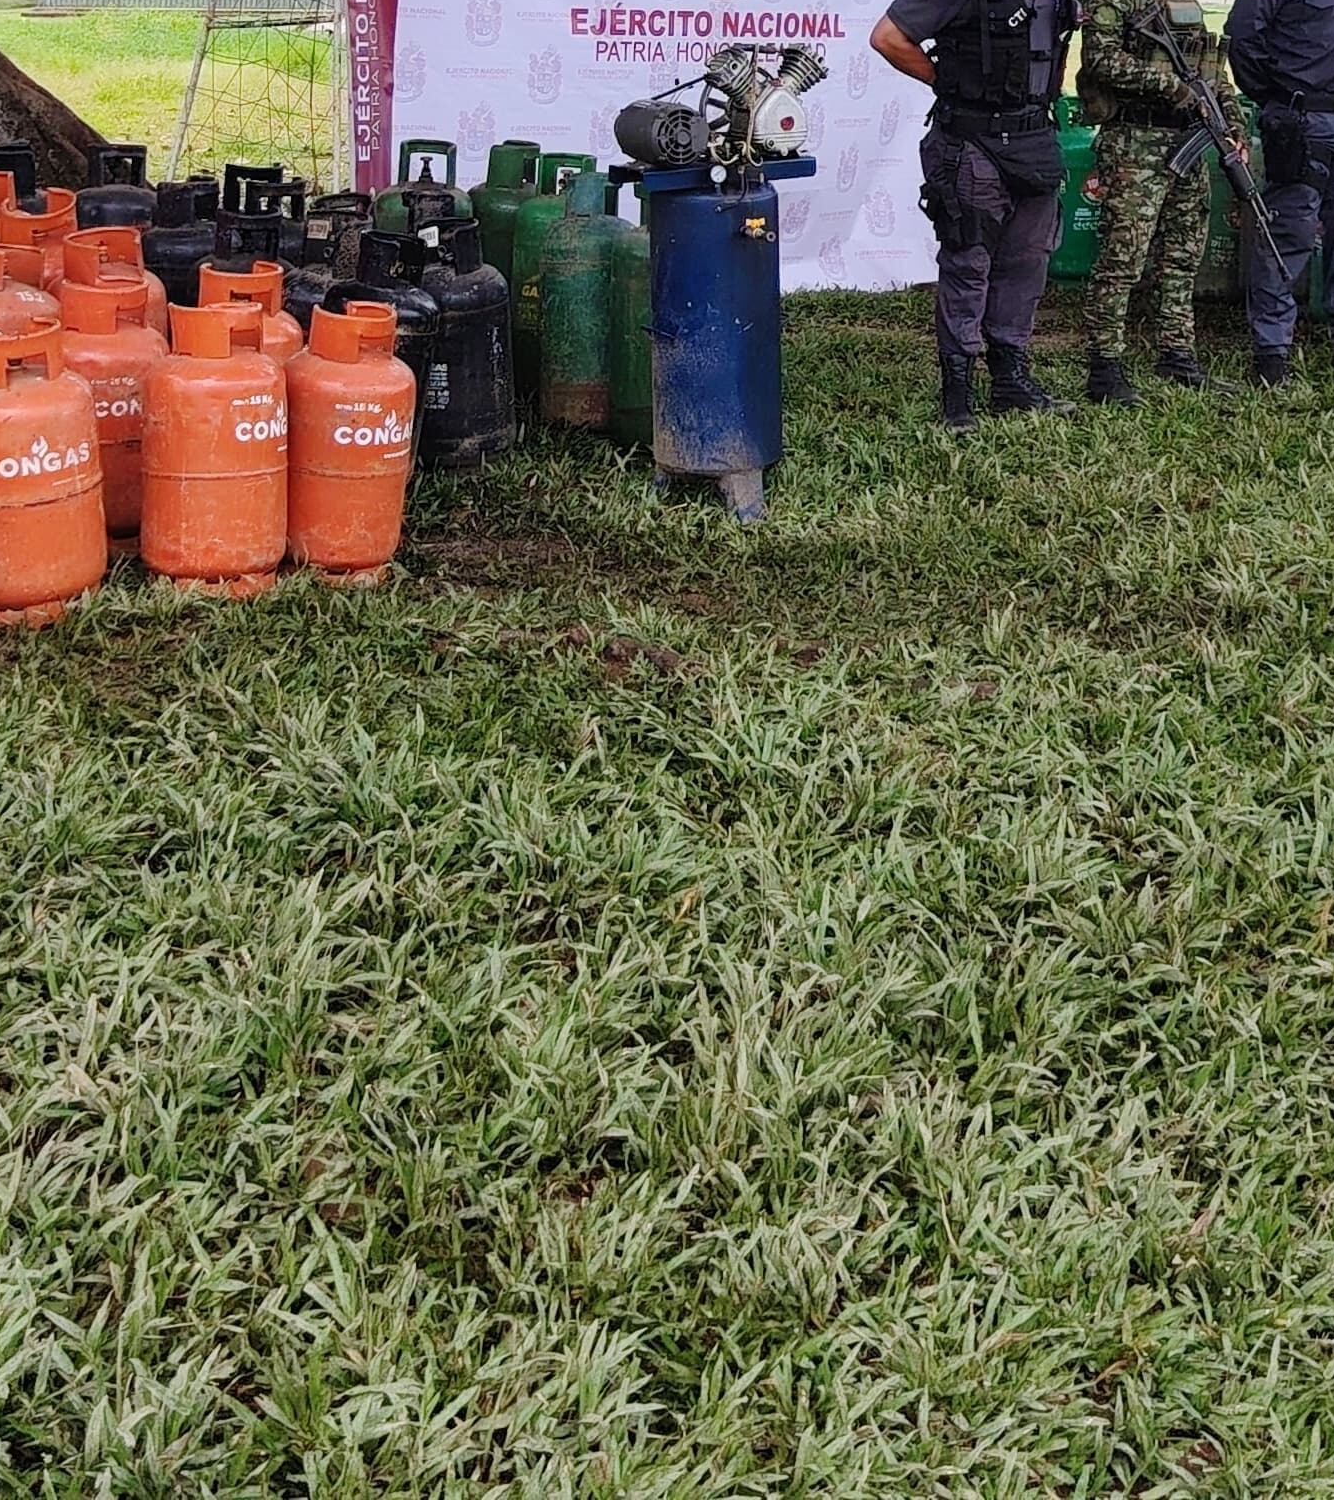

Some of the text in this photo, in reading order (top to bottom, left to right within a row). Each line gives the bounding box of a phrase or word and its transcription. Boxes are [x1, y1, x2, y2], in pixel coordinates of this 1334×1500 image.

[570, 3, 846, 38] EJÉRCITO NACIONAL
[1008, 7, 1027, 27] CTI
[595, 41, 665, 62] PATRIA
[354, 13, 371, 162] EJÉRCITO
[370, 69, 381, 151] PATRIA
[334, 419, 413, 446] CONGA
